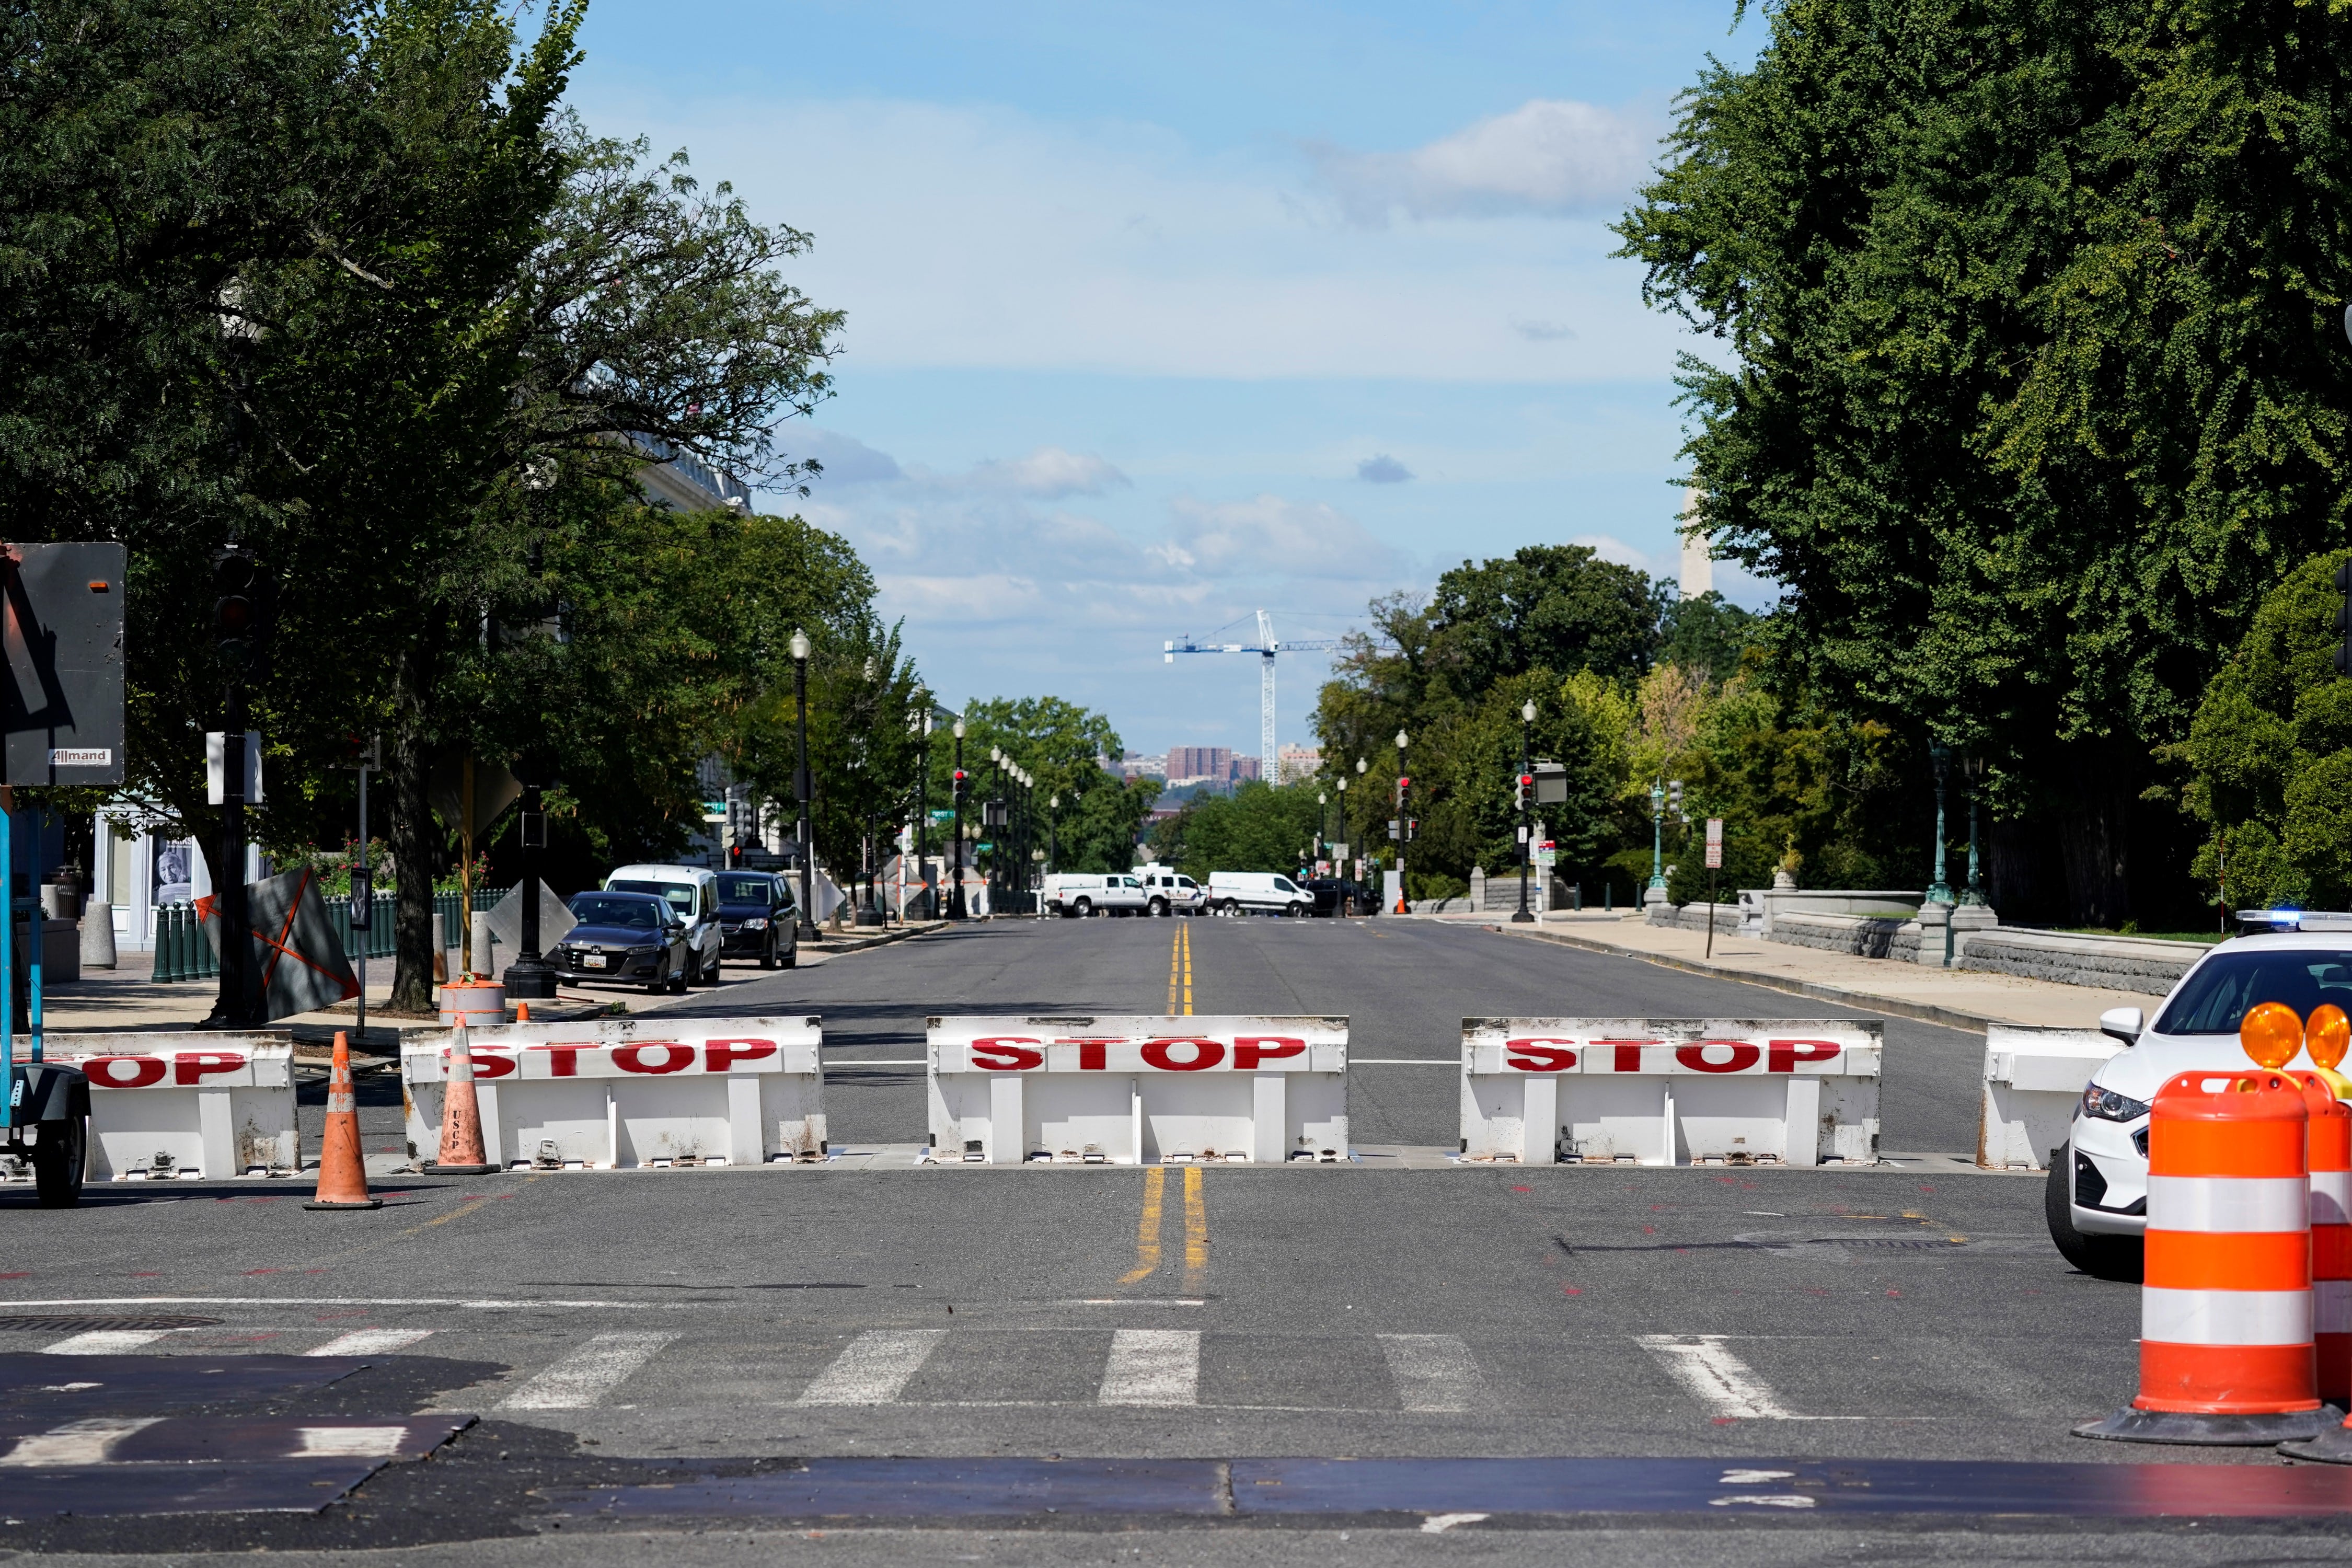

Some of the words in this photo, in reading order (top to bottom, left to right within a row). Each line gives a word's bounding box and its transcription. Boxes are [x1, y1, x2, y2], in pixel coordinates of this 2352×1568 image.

[51, 751, 106, 763] Allmand
[442, 1039, 777, 1078] STOP
[972, 1037, 1306, 1070] STOP
[1506, 1039, 1840, 1073] STOP
[452, 1110, 461, 1149] USCP
